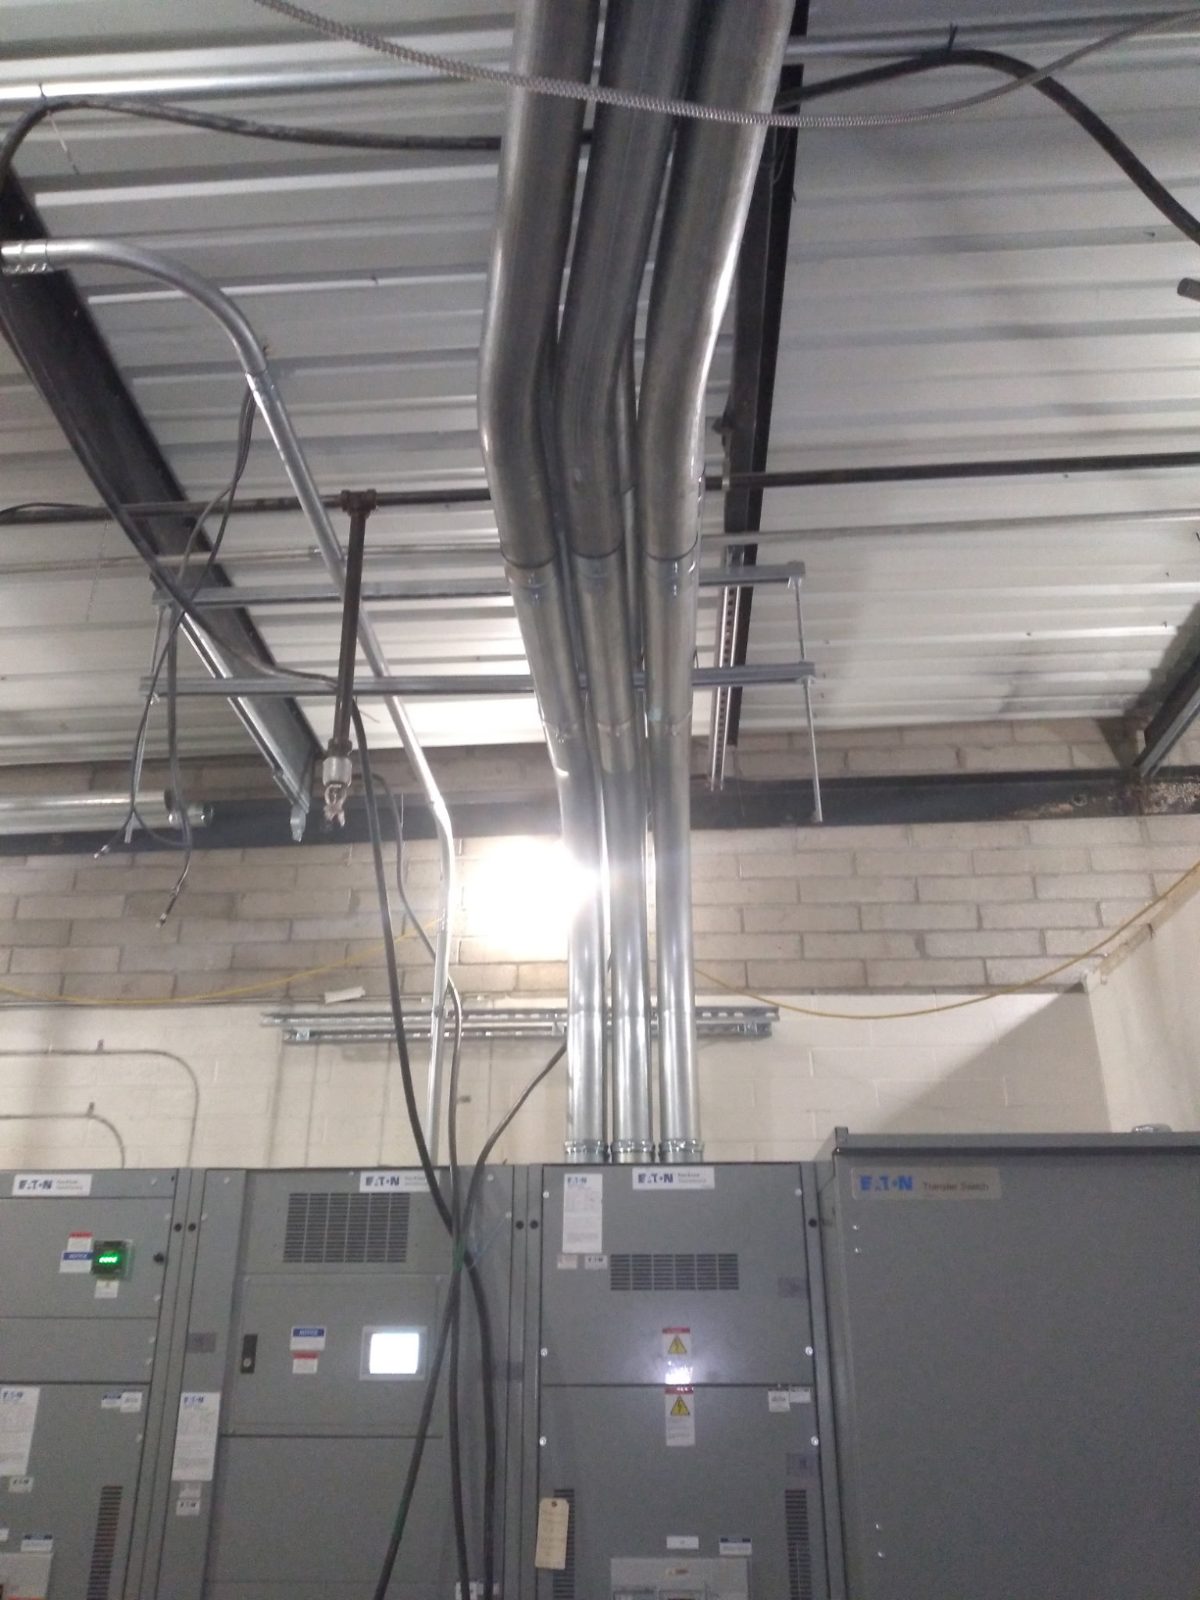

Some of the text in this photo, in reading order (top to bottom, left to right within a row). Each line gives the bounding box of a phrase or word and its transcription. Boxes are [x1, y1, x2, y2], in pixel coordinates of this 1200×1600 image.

[365, 1176, 399, 1187] EATON
[637, 1173, 673, 1184] EATON
[860, 1175, 913, 1191] EATON
[18, 1180, 52, 1190] EATON
